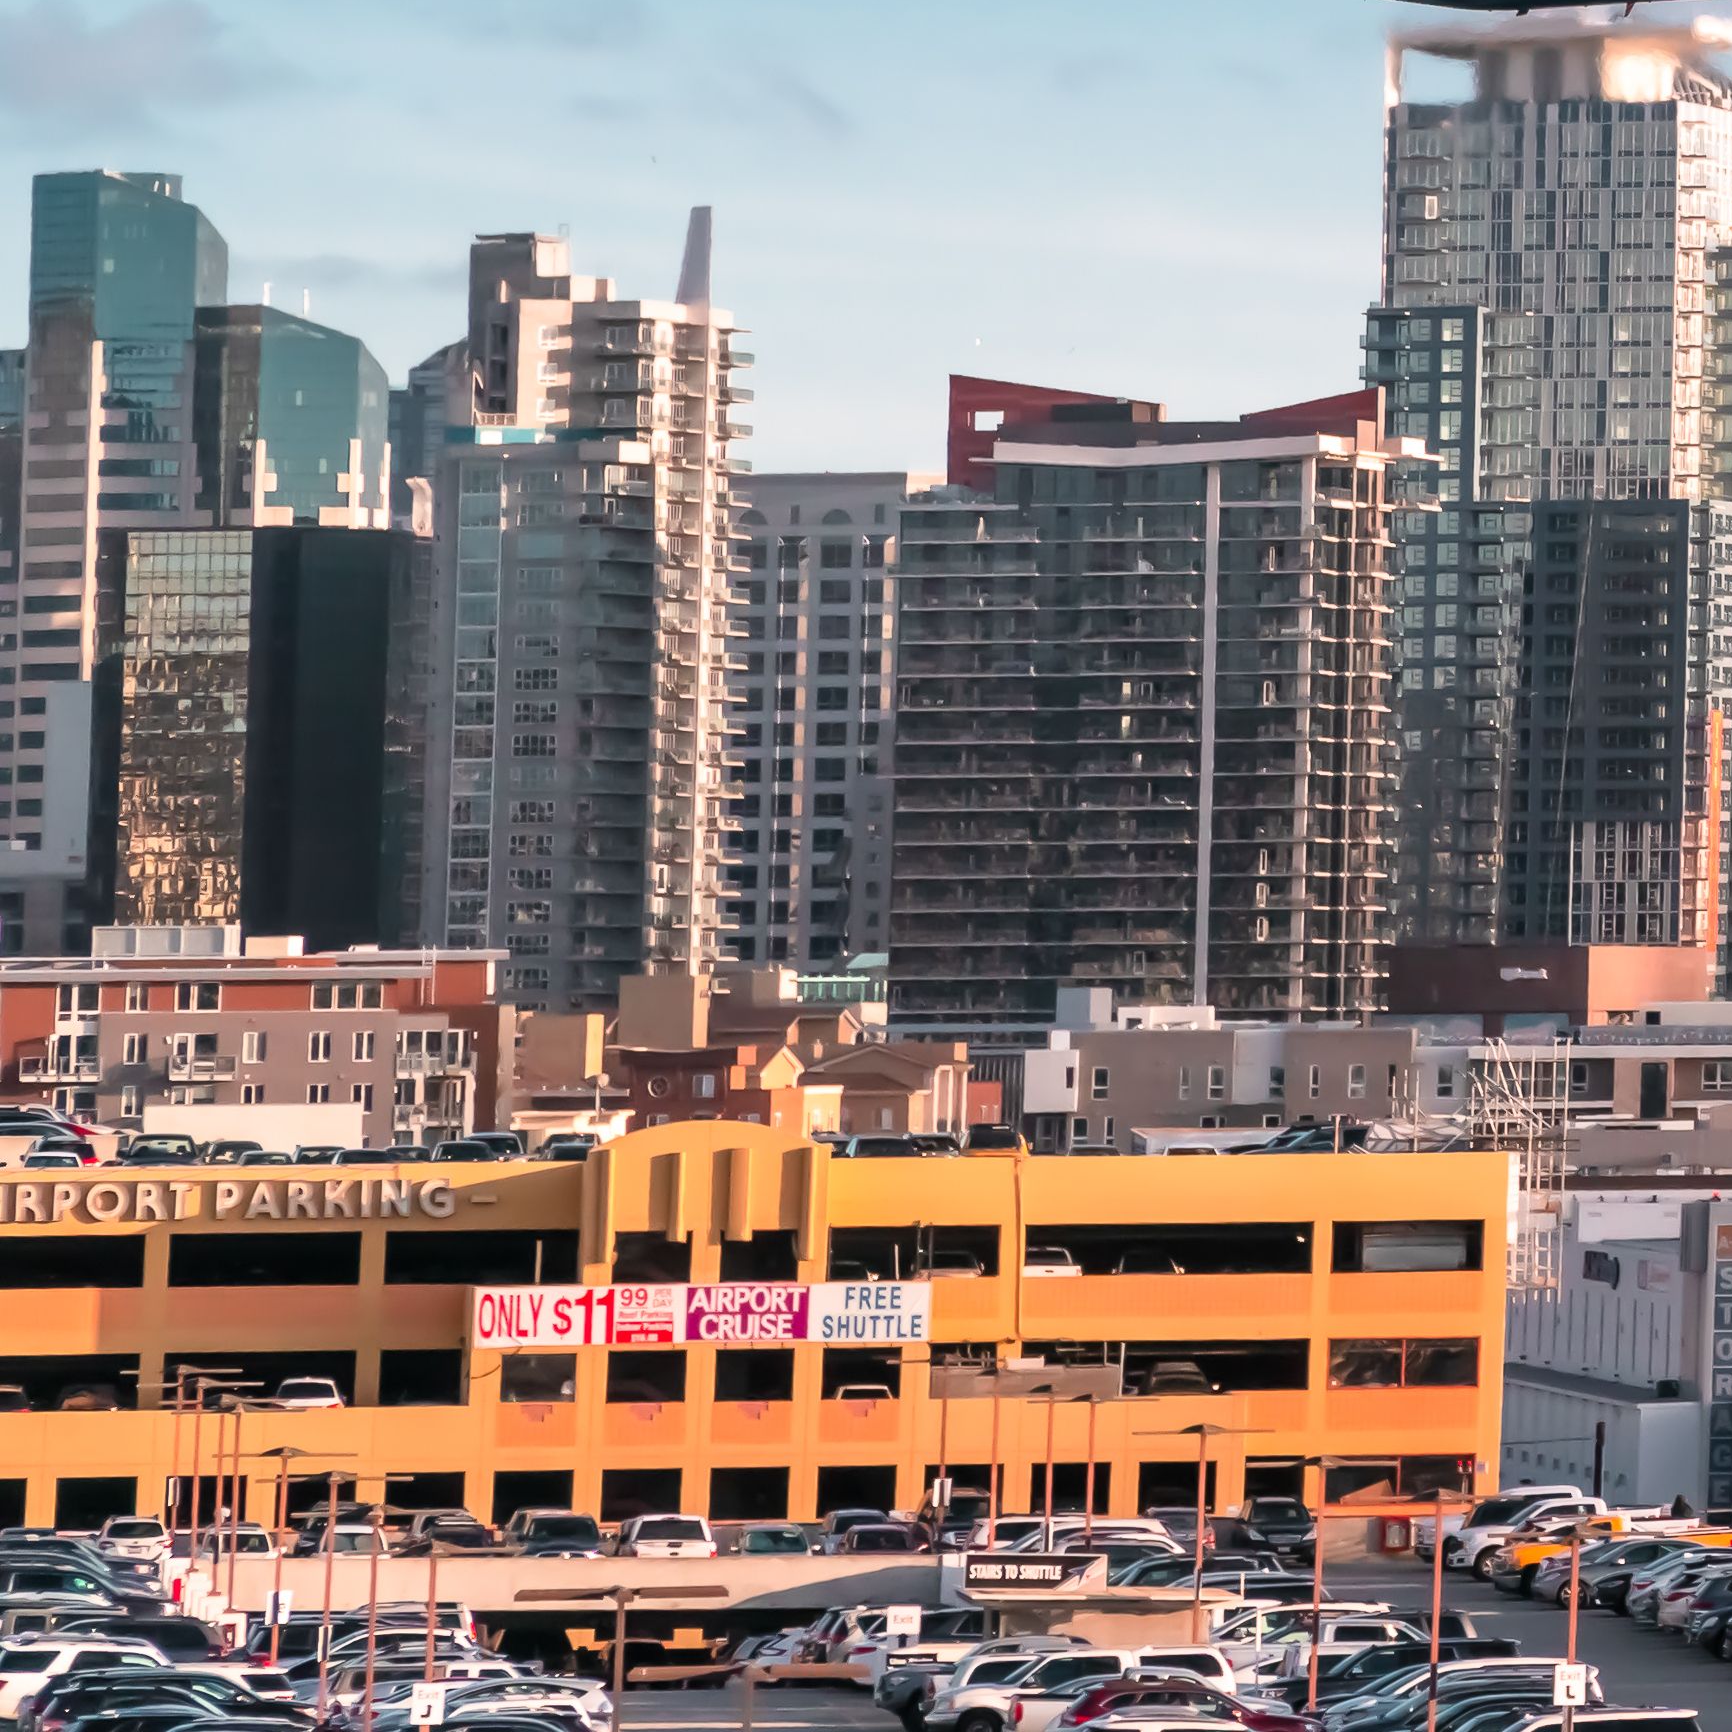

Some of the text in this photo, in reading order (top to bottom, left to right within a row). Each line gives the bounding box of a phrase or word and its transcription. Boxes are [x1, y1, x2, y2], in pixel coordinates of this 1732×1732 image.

[215, 1178, 456, 1219] PARKING
[620, 1288, 648, 1307] 99
[653, 1298, 673, 1309] DAY
[688, 1286, 807, 1313] AIRPORT
[845, 1286, 901, 1310] FREE
[479, 1288, 615, 1345] ONLY $11
[699, 1313, 793, 1340] CRUISE
[822, 1314, 922, 1339] SHUTTLE
[969, 1564, 1062, 1581] STAIRS TO SHUTTLE
[1560, 1670, 1581, 1681] Exit
[1566, 1685, 1576, 1699] L
[420, 1704, 432, 1718] J
